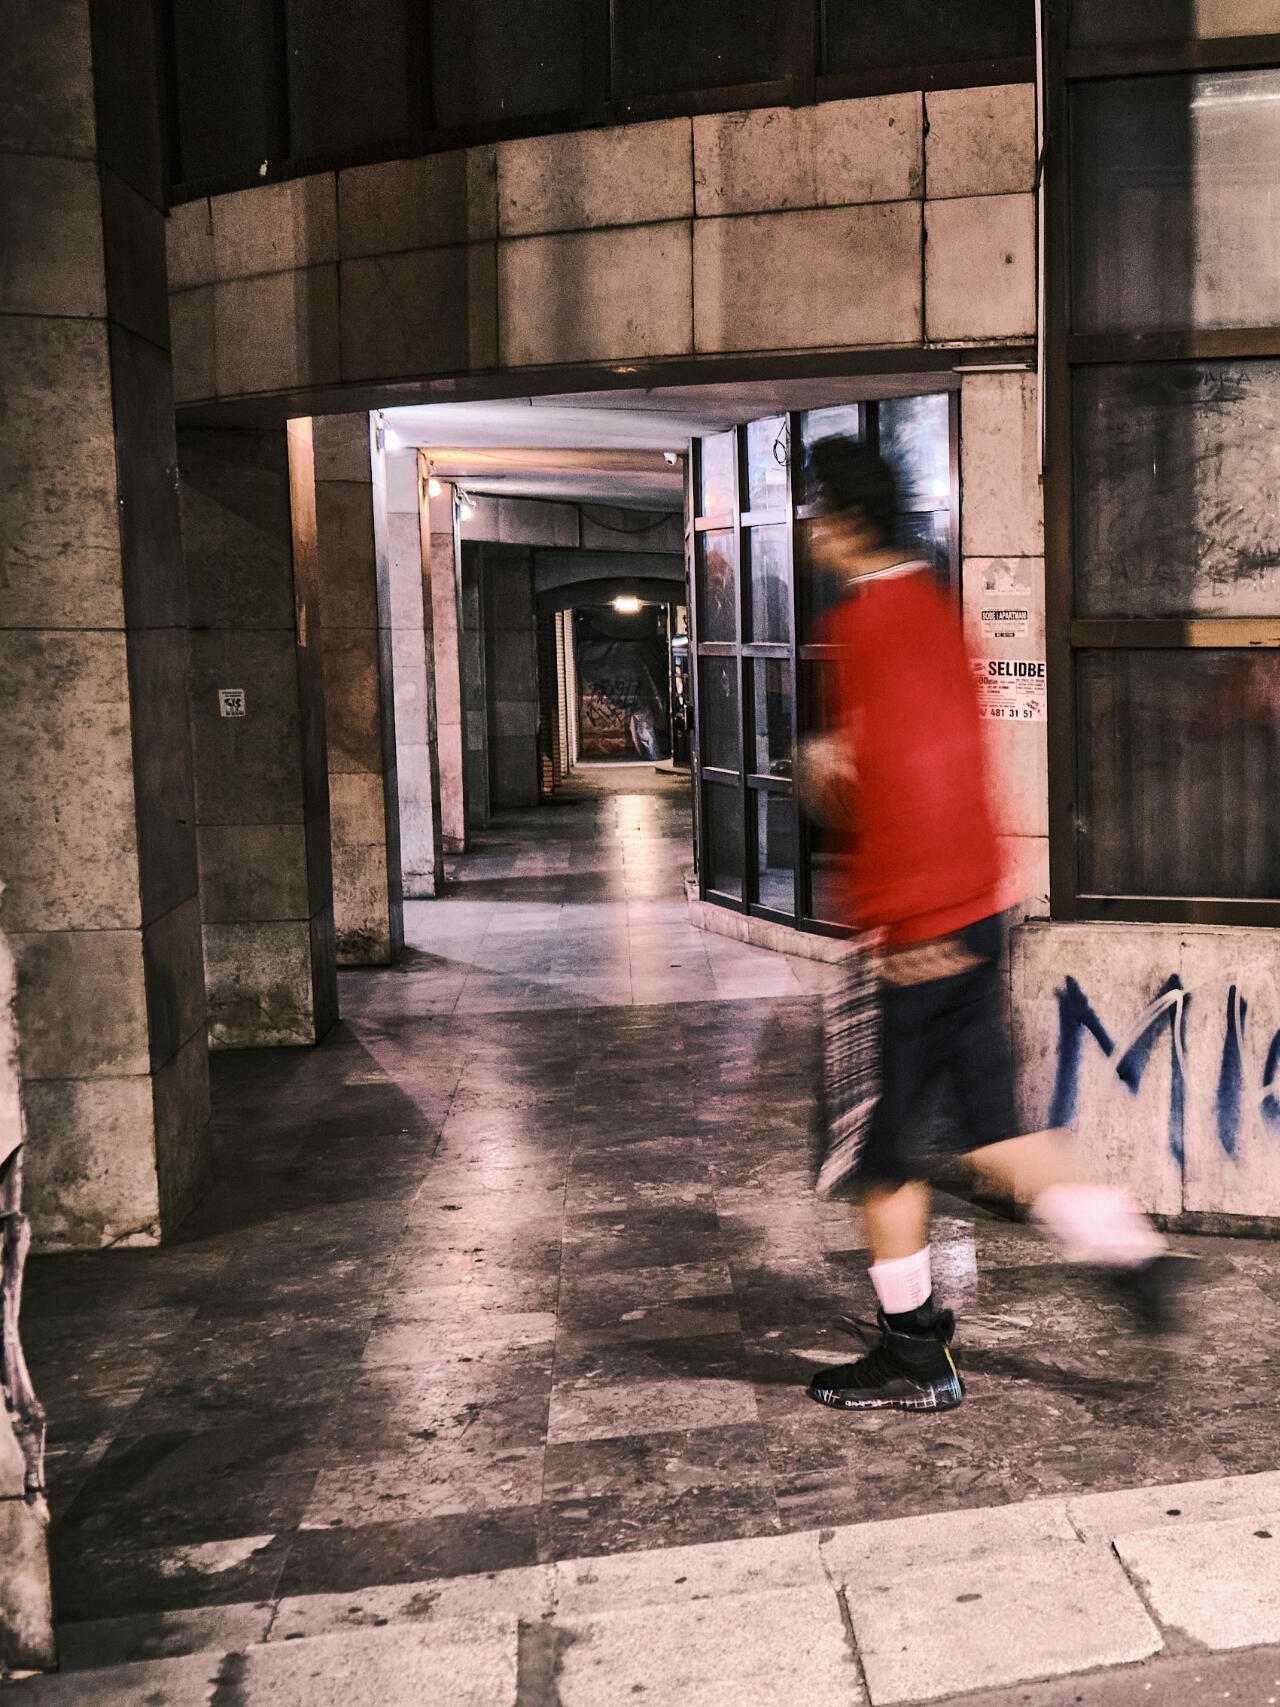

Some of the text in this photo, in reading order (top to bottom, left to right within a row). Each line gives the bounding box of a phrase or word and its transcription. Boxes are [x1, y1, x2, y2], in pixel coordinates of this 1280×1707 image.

[988, 661, 1045, 678] SELIDBE
[991, 708, 1005, 718] 481
[1009, 708, 1019, 718] 31
[1023, 709, 1033, 719] 51
